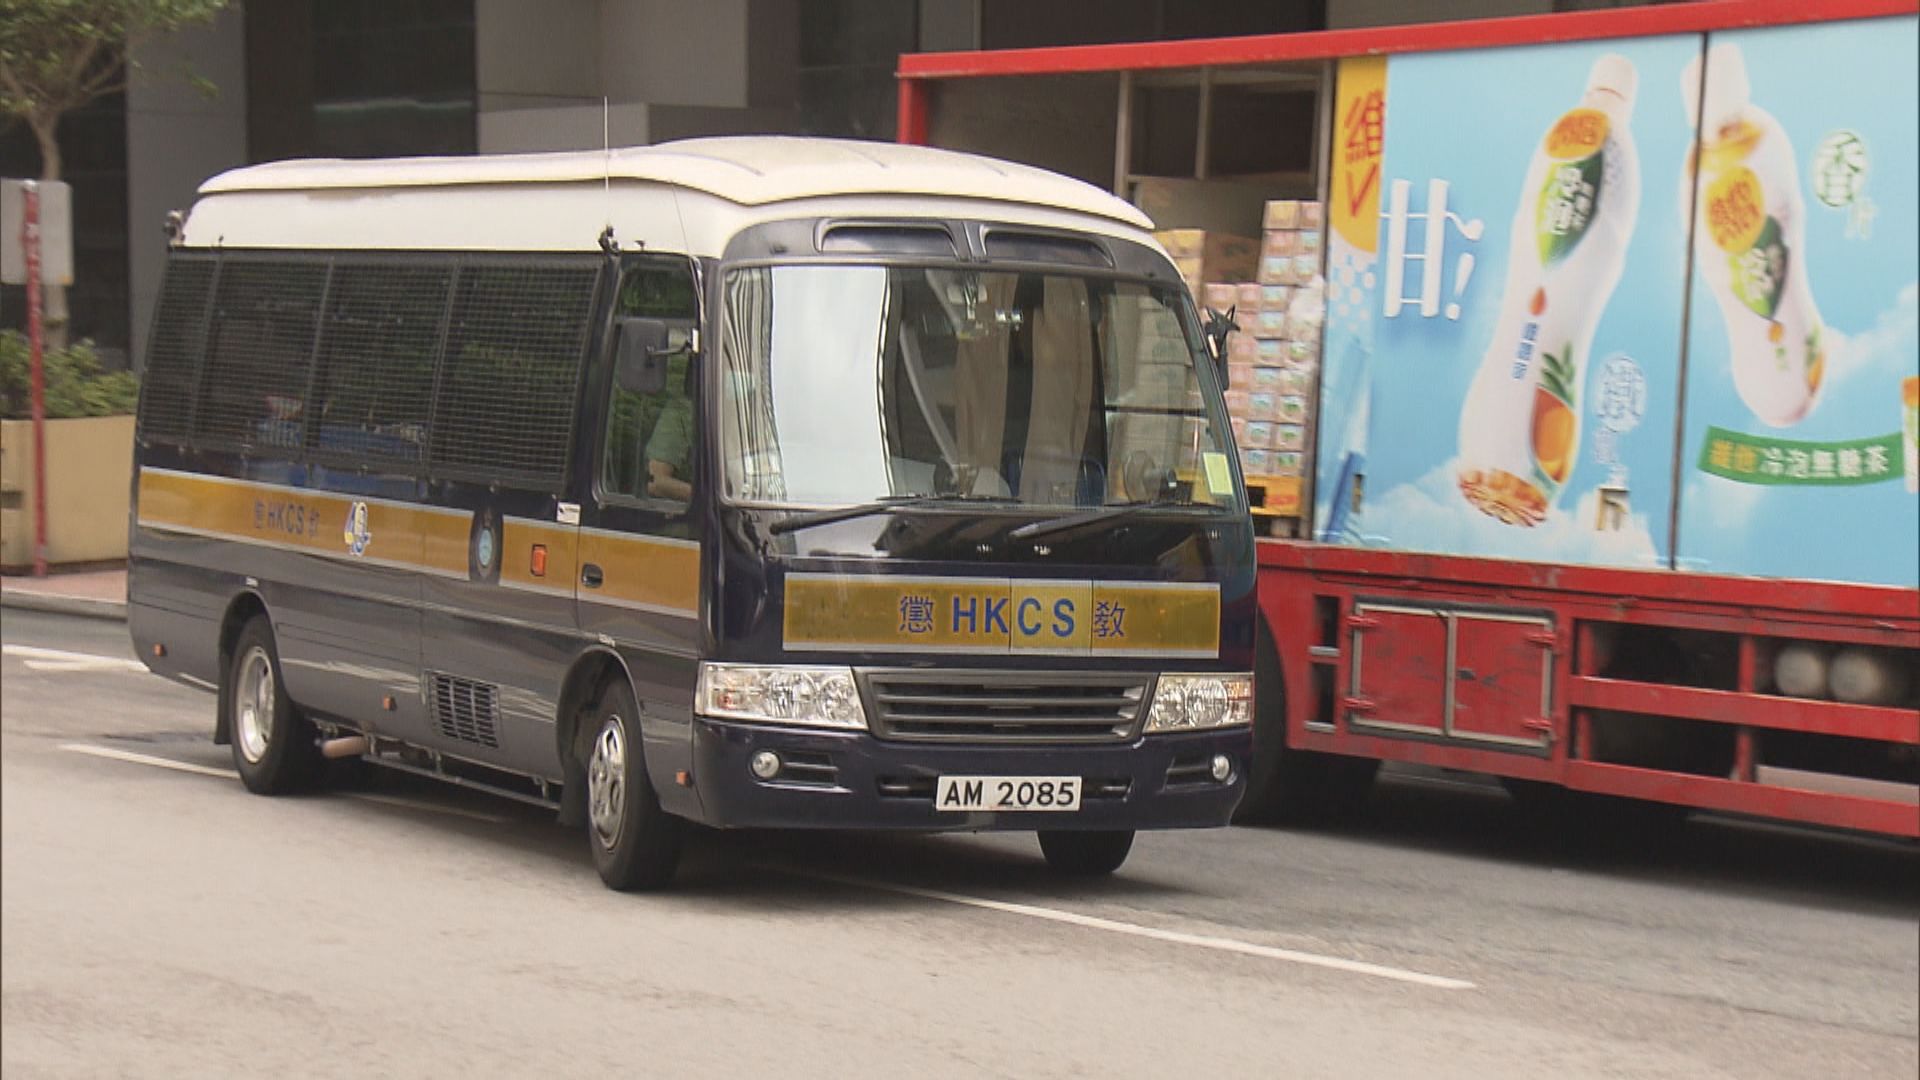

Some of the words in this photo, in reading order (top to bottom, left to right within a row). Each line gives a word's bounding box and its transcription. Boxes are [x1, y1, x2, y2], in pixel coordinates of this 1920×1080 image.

[900, 595, 935, 634] 懲
[952, 597, 1075, 637] HKCS
[943, 780, 983, 807] AM
[997, 781, 1074, 806] 2085
